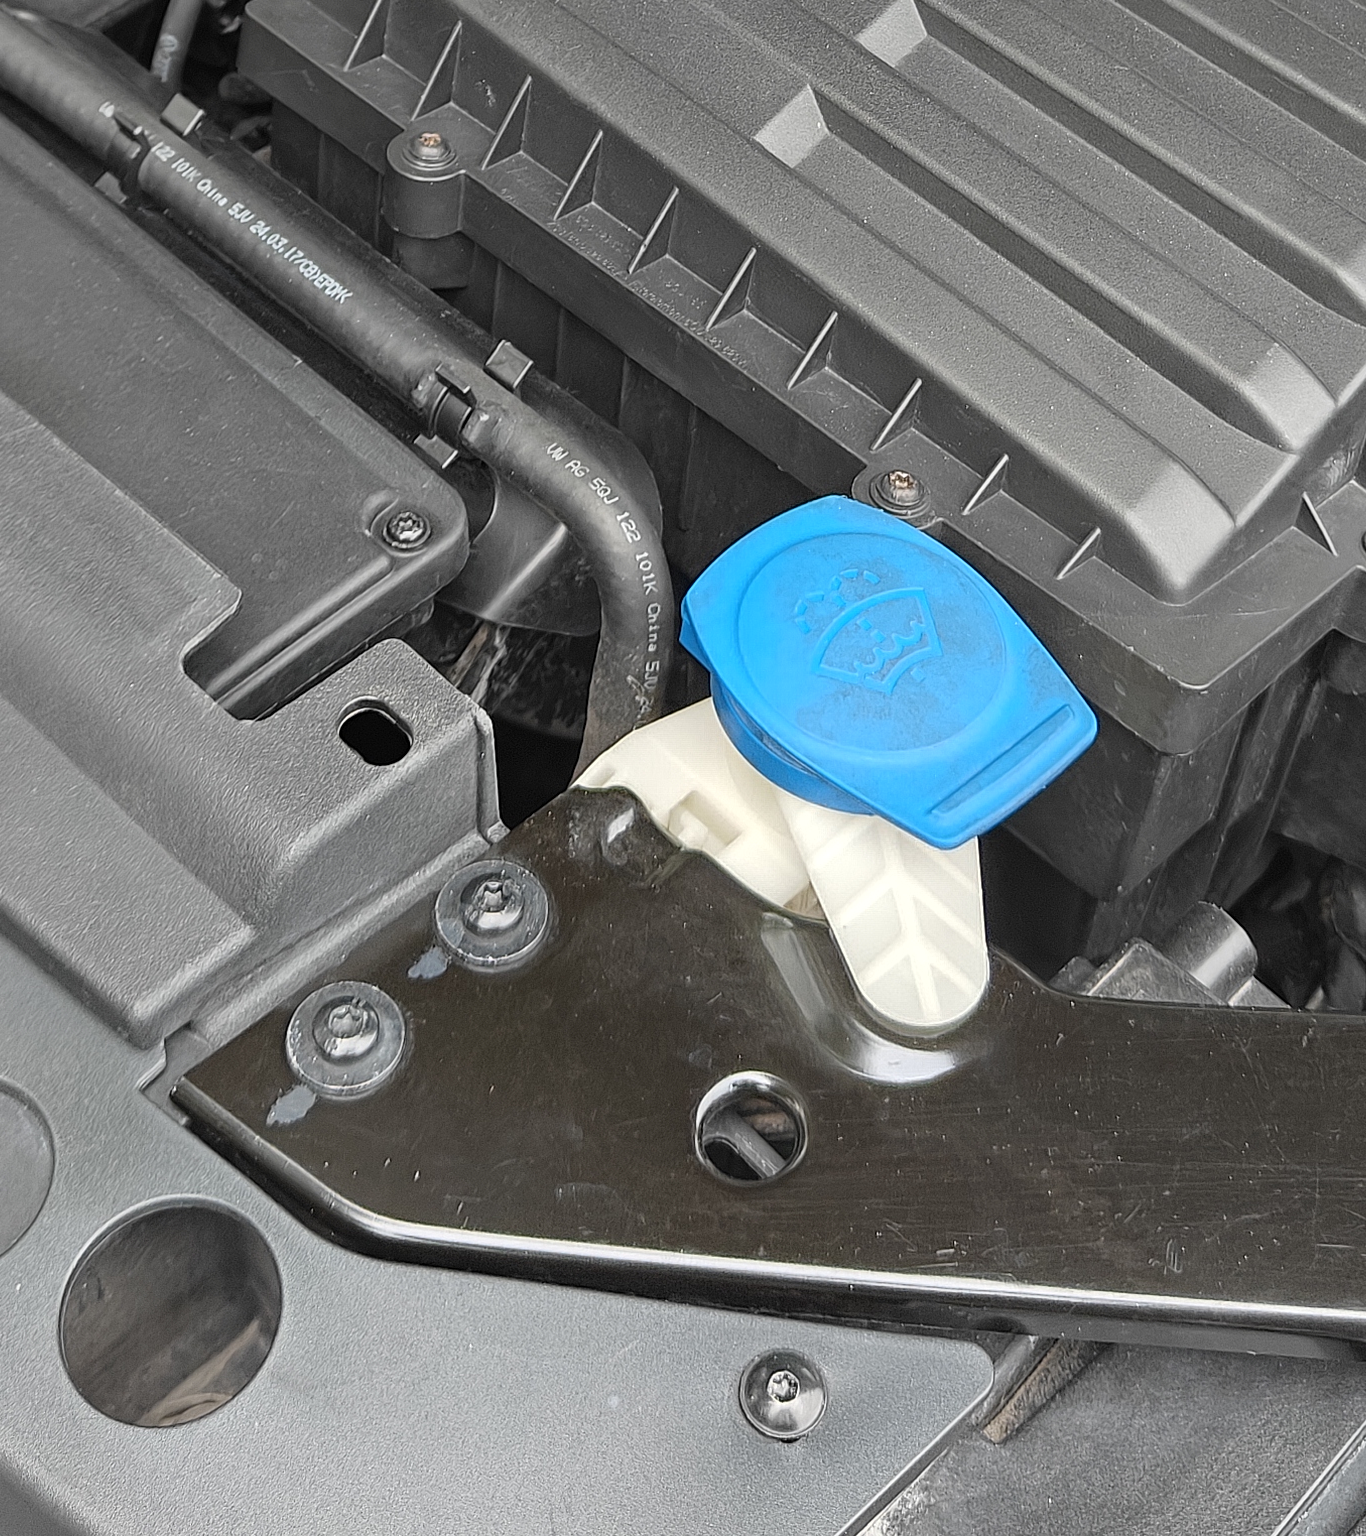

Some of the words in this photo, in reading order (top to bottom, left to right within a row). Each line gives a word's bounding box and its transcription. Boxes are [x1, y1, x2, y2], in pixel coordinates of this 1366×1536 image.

[151, 141, 176, 162] 122
[171, 157, 202, 183] 101K
[196, 178, 228, 208] China
[546, 442, 570, 461] VW
[564, 459, 590, 478] AG
[588, 477, 620, 505] 5QJ
[616, 511, 642, 544] 122
[635, 551, 659, 596] 101K
[646, 602, 661, 653] China
